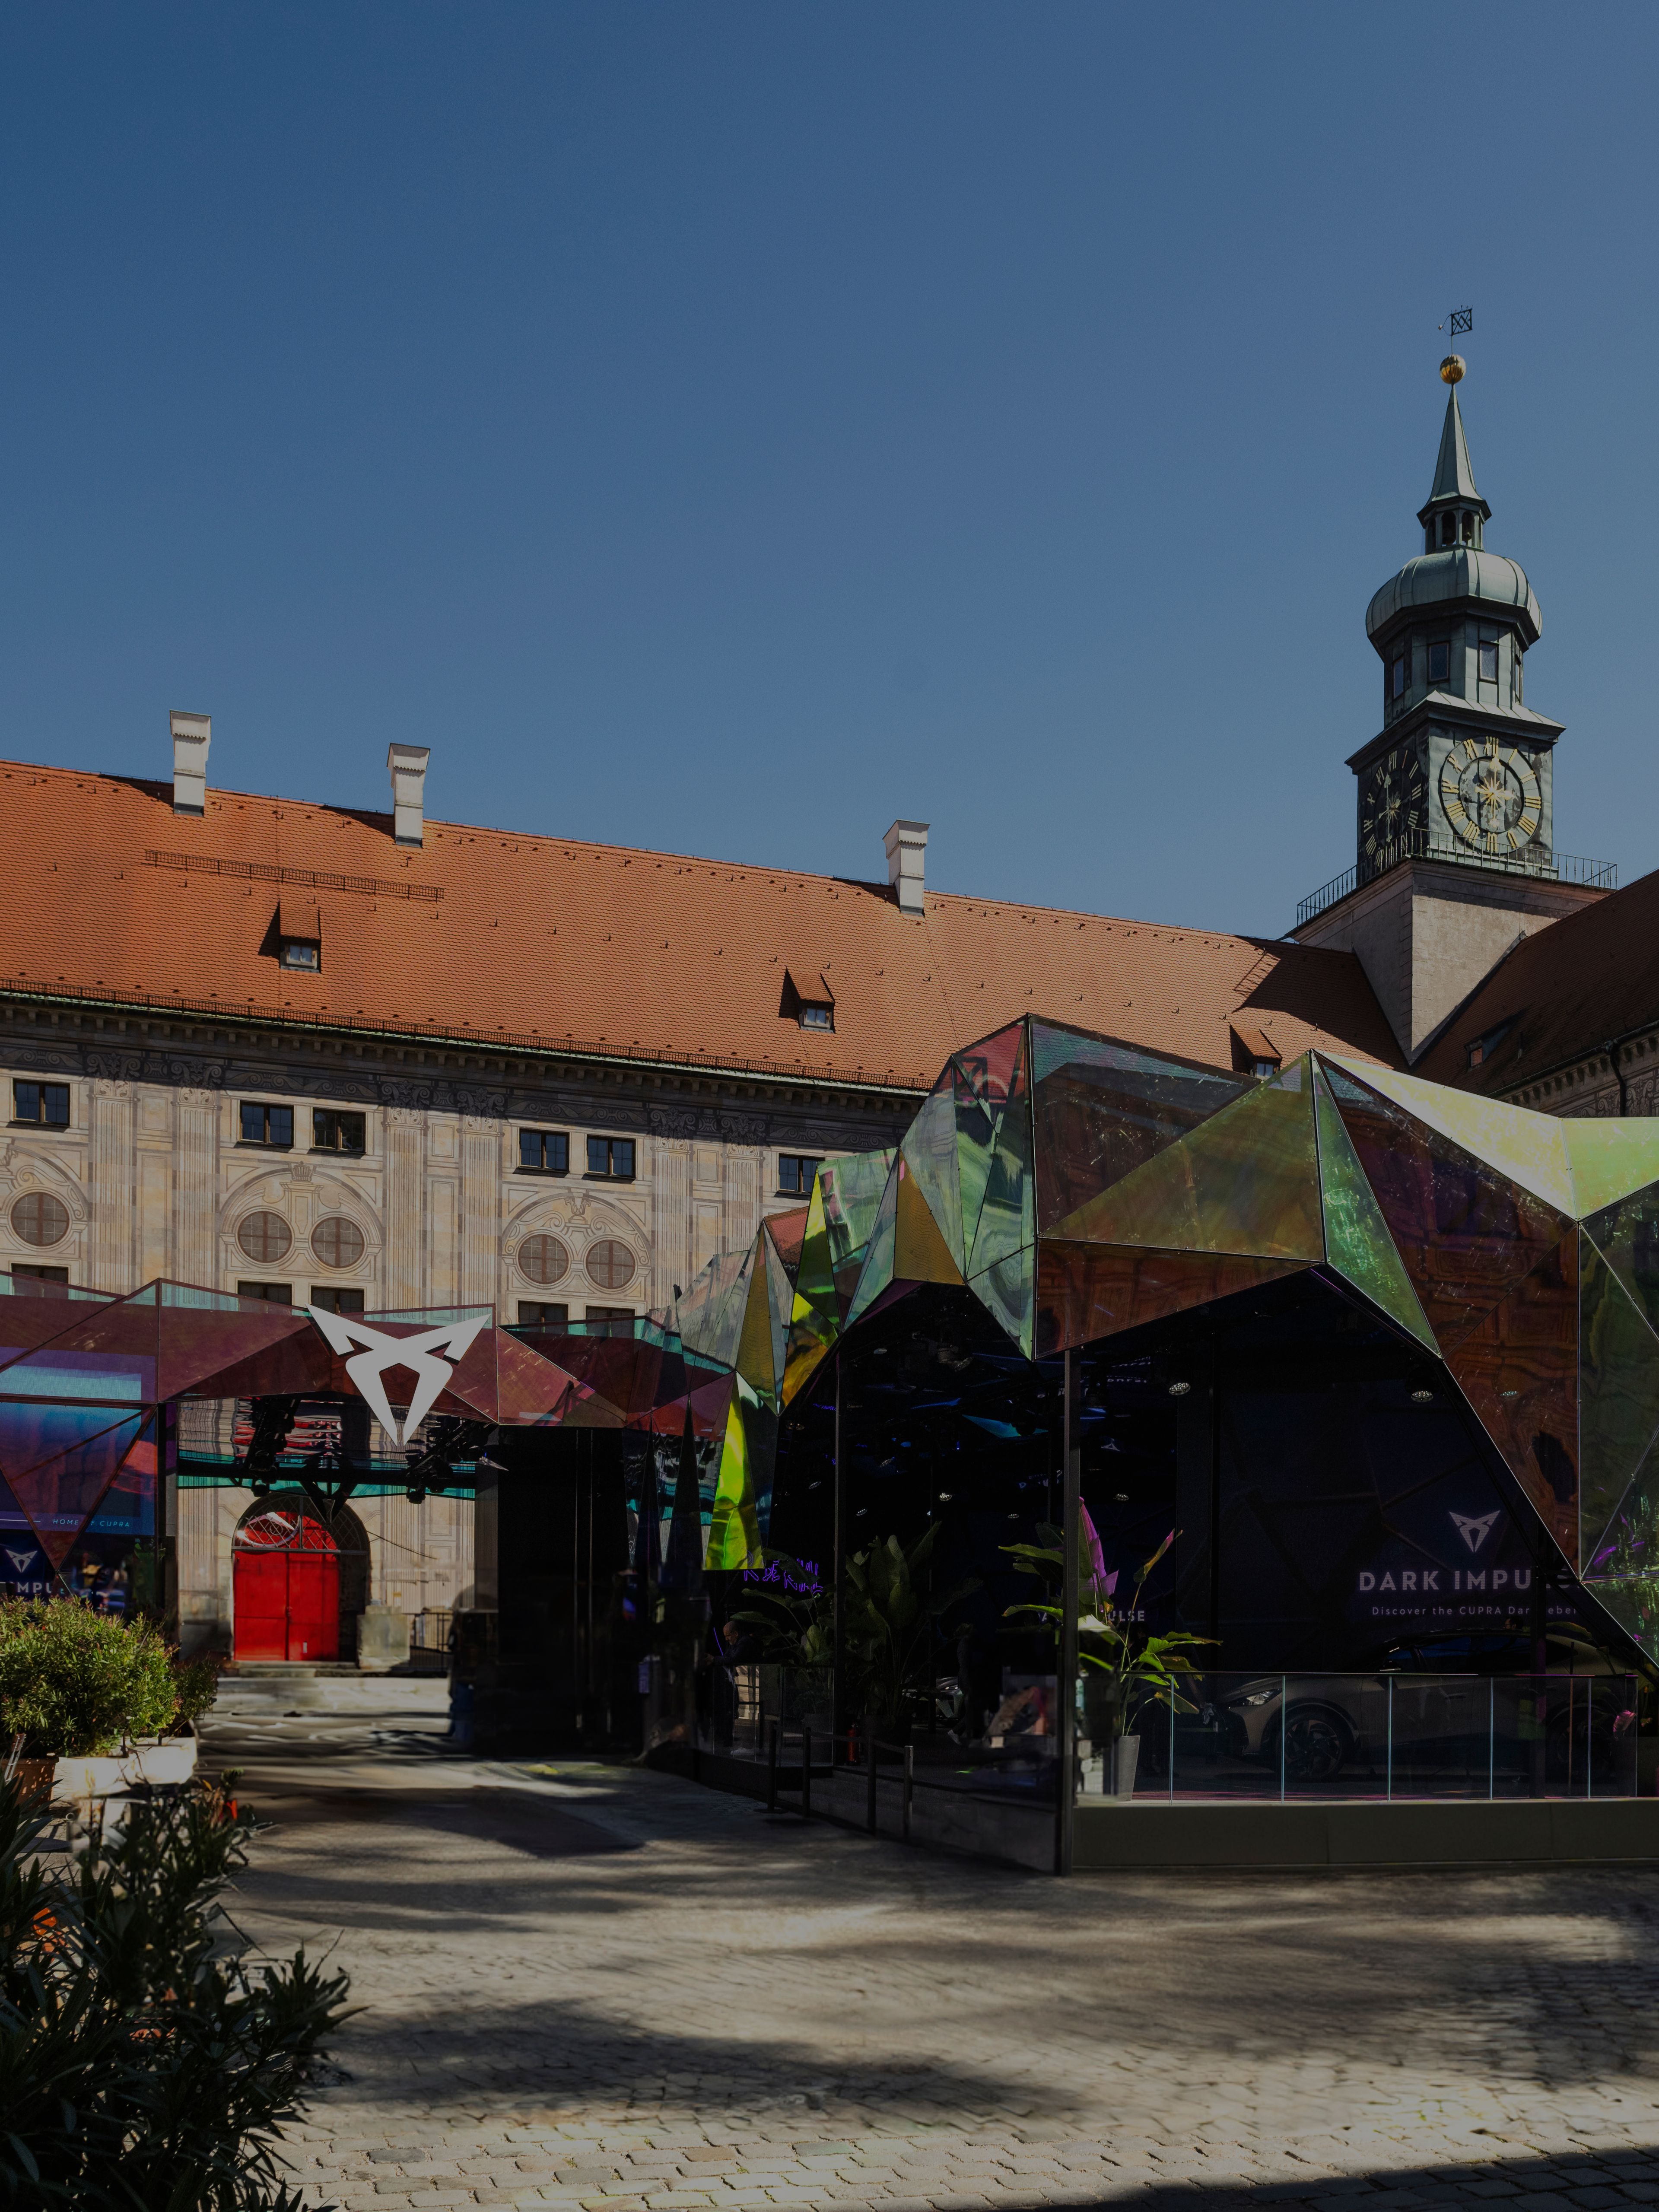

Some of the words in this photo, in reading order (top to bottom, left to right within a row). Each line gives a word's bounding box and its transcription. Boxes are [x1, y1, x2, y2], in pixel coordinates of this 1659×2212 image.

[1463, 738, 1479, 760] XI
[1483, 736, 1499, 757] XII
[1448, 753, 1464, 773] X
[1508, 748, 1518, 764] I
[1520, 770, 1536, 783] II
[1442, 778, 1459, 794] IX
[1525, 796, 1541, 809] III
[1446, 801, 1466, 825] VIII
[1518, 814, 1537, 836] IIII
[1487, 832, 1497, 852] VI
[1507, 831, 1519, 849] V
[1360, 1571, 1439, 1590] DARK
[1108, 1610, 1145, 1621] ULSE
[1372, 1607, 1426, 1615] Discover
[1433, 1606, 1452, 1615] the
[1459, 1606, 1501, 1615] CUPRA
[1508, 1606, 1530, 1615] Dar
[1548, 1605, 1576, 1615] ebe
